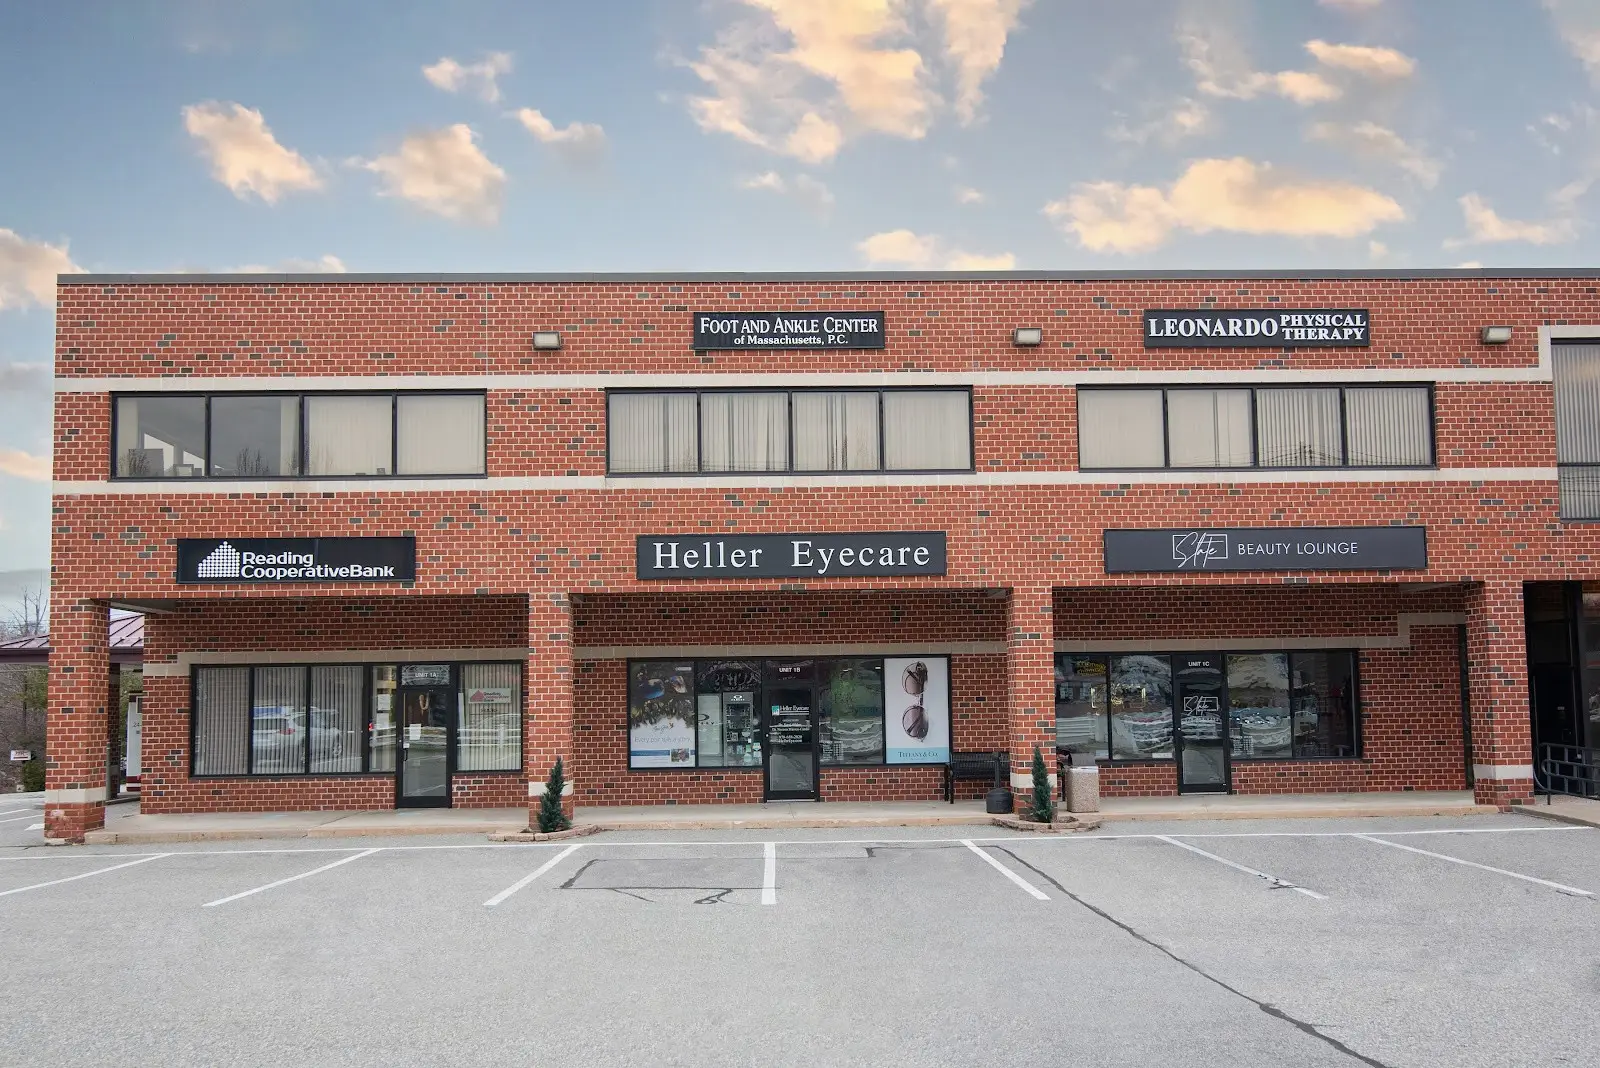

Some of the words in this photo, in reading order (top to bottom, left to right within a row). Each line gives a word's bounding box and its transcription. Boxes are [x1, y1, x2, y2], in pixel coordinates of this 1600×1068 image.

[700, 317, 739, 334] FOOT
[741, 318, 770, 334] AND
[773, 316, 819, 334] ANKLE
[823, 316, 878, 333] CENTER
[1148, 318, 1278, 338] LEONARDO
[1280, 314, 1366, 327] PHYSICAL
[734, 335, 745, 345] of
[747, 334, 825, 346] Massachusetts,
[828, 335, 848, 344] P.C.
[1282, 327, 1365, 341] THERAPY
[1238, 542, 1291, 555] BEAUTY
[1297, 541, 1358, 555] LOUNGE
[242, 551, 314, 567] Reading
[652, 541, 763, 569] Heller
[790, 540, 931, 574] Eyecare
